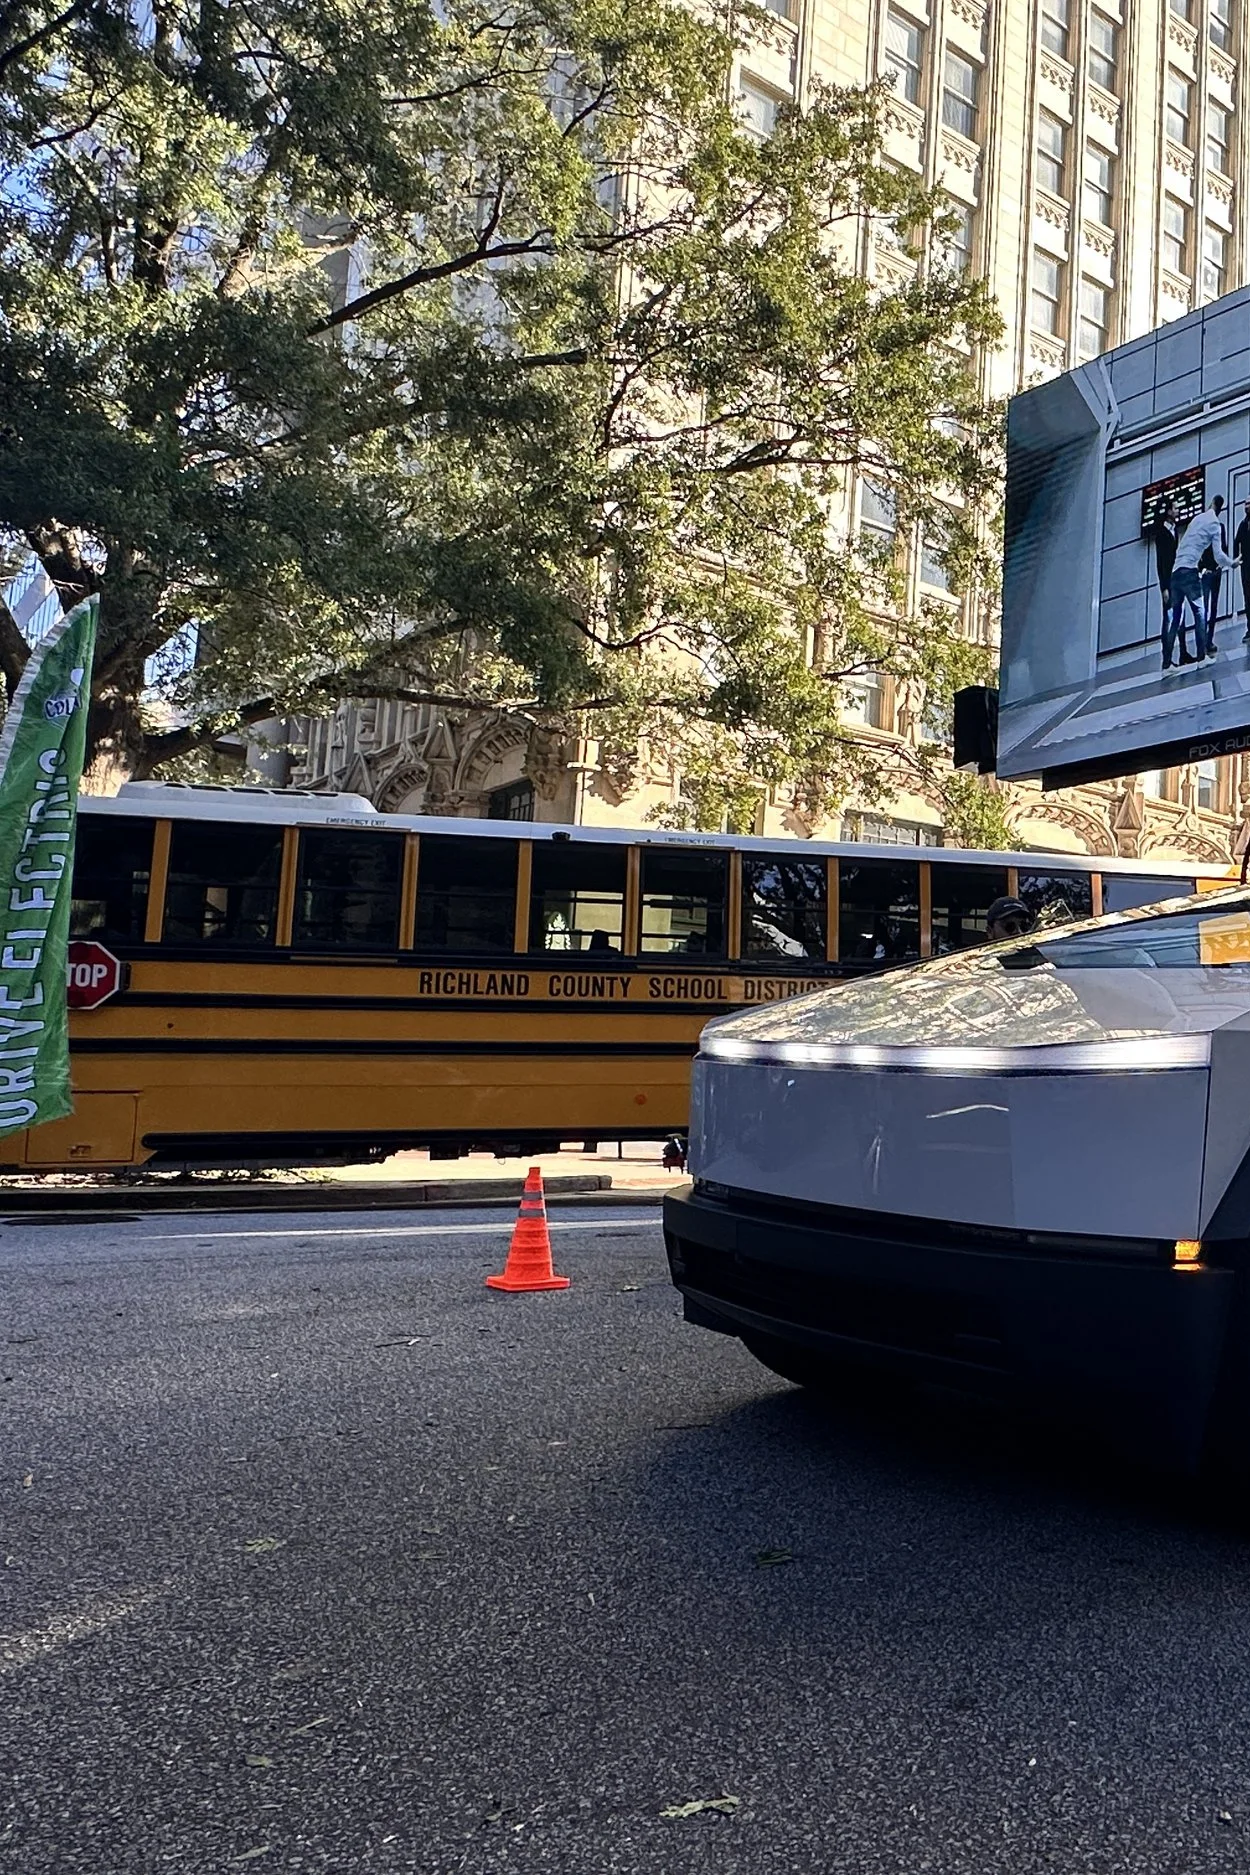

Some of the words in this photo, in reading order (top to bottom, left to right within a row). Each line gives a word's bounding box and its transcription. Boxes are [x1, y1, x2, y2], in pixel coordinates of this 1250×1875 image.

[1188, 742, 1222, 759] FOX
[66, 963, 108, 988] TOP
[419, 971, 530, 996] RICHLAND
[548, 974, 631, 998] COUNTY
[648, 977, 728, 999] SCHOOL
